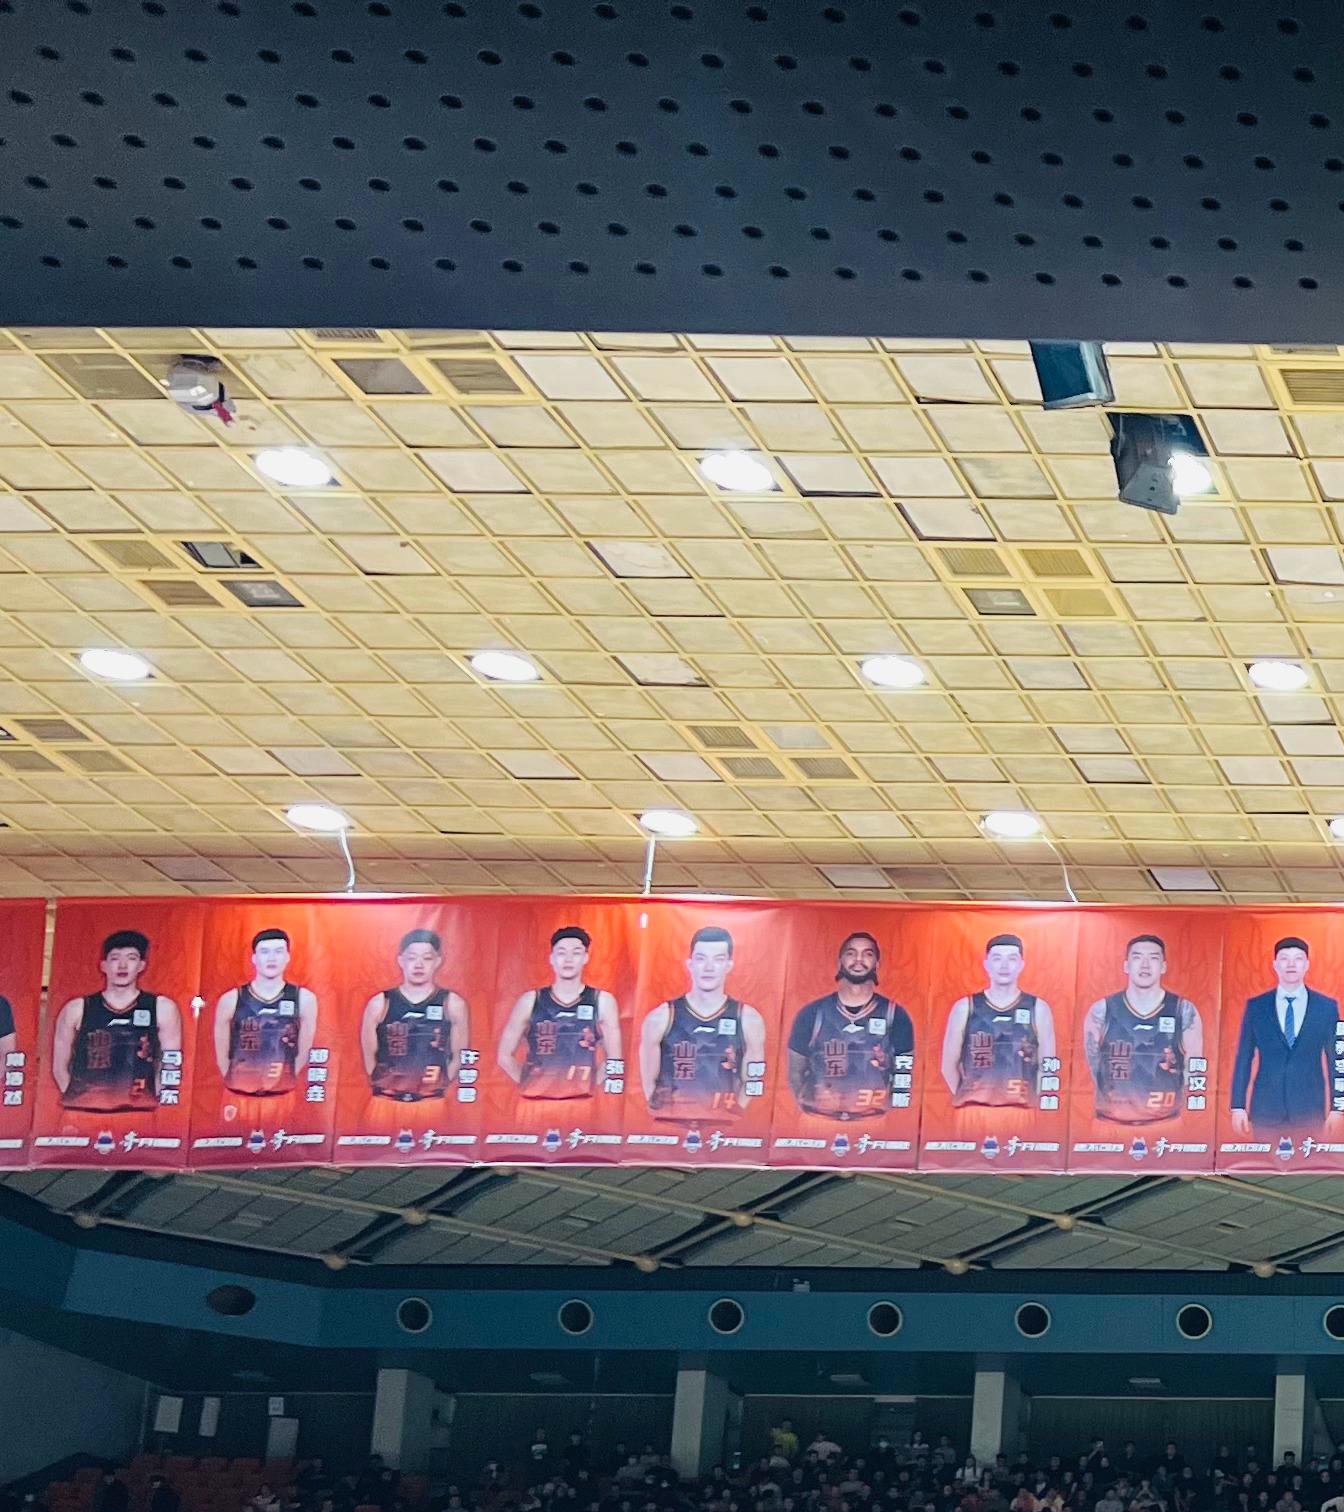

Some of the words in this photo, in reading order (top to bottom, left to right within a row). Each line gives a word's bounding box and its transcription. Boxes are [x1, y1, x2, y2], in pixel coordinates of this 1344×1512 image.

[240, 1016, 262, 1051] 山东
[386, 1020, 409, 1057] 山东
[535, 1019, 558, 1055] 山东
[970, 1031, 993, 1068] 山东
[566, 1065, 592, 1081] 17
[672, 1040, 698, 1080] 山东
[824, 1038, 848, 1078] 山东
[1110, 1040, 1132, 1080] 山东
[856, 1089, 887, 1106] 32
[891, 1054, 913, 1108] 克里斯
[711, 1092, 736, 1109] 14
[1146, 1091, 1175, 1109] 20
